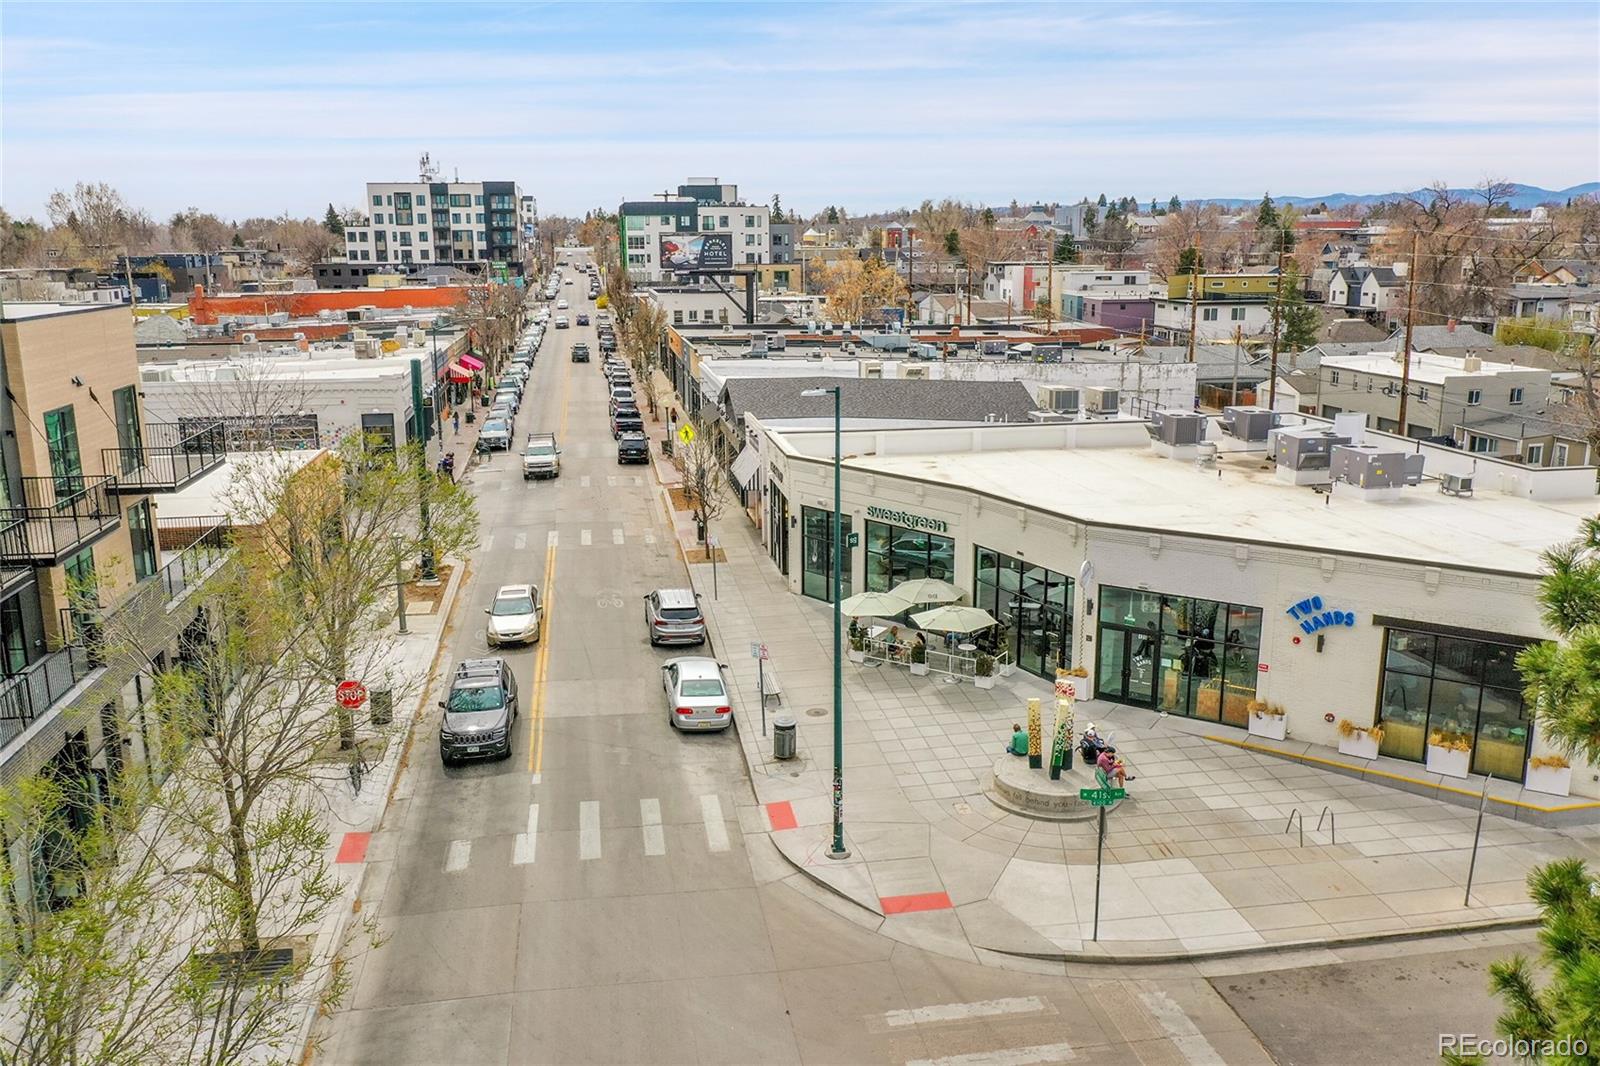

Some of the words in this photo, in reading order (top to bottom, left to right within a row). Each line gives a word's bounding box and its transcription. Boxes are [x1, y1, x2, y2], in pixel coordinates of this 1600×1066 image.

[866, 505, 948, 533] sweetgreen
[1286, 595, 1324, 621] TWO
[1299, 610, 1355, 635] HANDS
[338, 690, 364, 701] STOP
